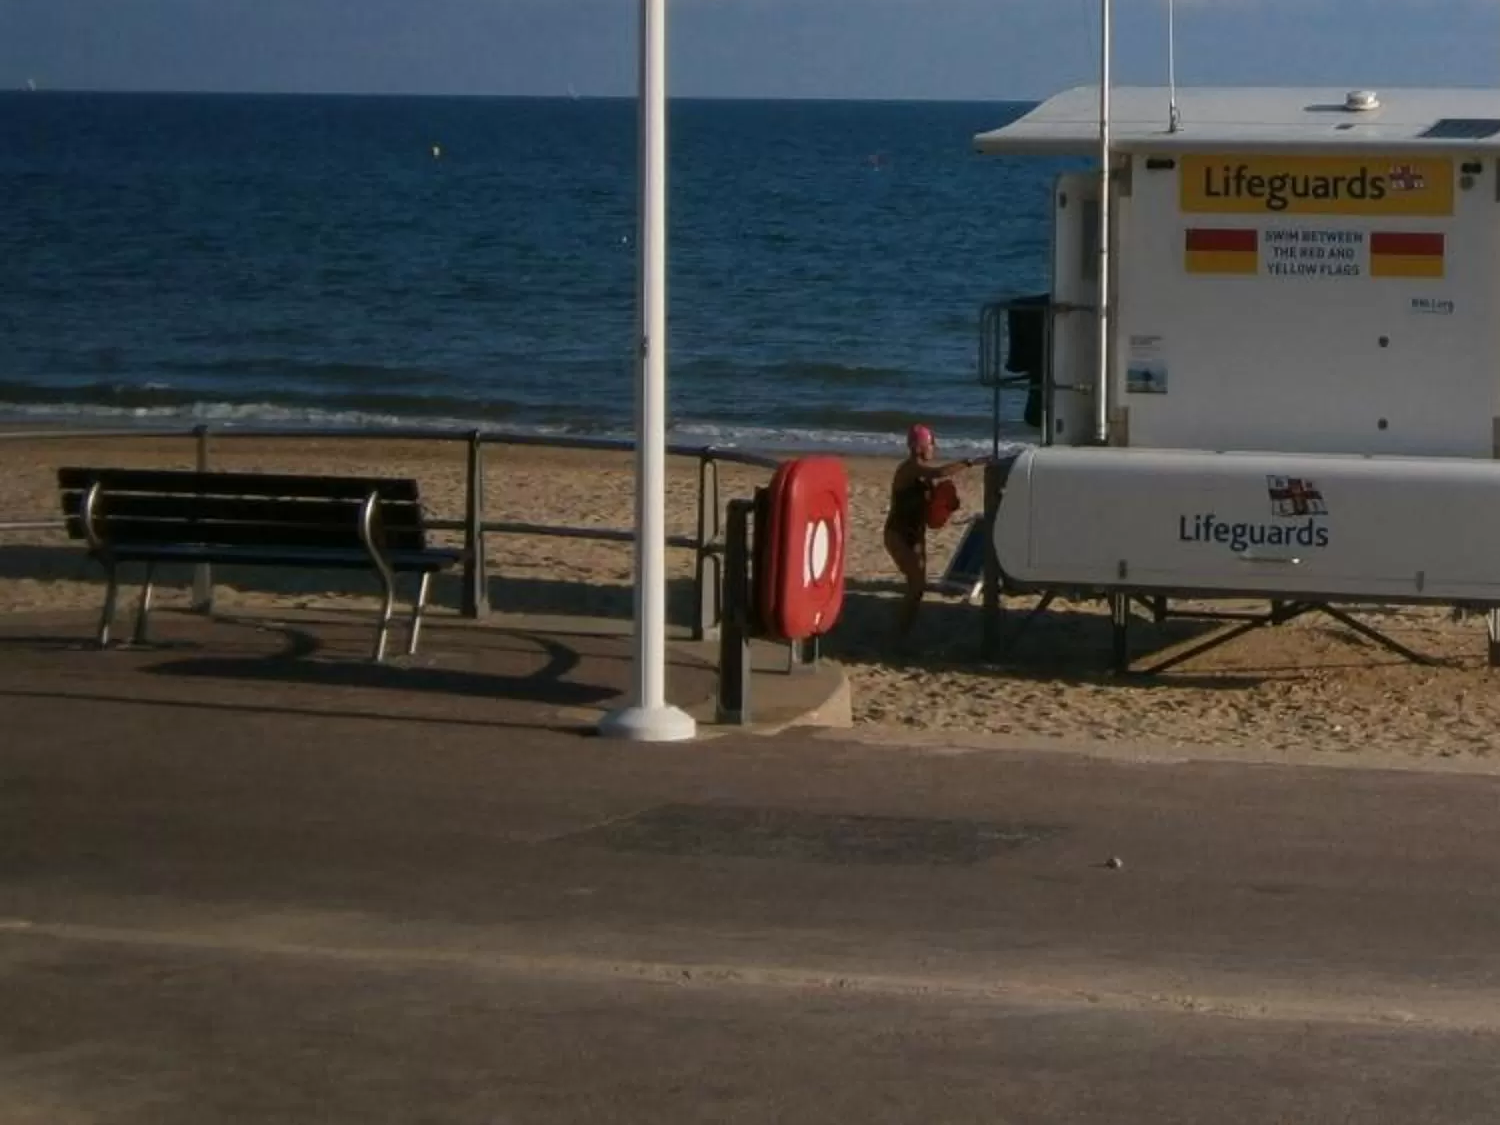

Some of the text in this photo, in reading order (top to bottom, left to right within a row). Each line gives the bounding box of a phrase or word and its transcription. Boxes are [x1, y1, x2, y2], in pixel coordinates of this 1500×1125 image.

[1203, 165, 1386, 211] Lifeguards
[1265, 230, 1299, 243] SWIM
[1273, 246, 1297, 259] THE
[1327, 248, 1355, 261] AND
[1267, 262, 1317, 276] YELLOW
[1179, 514, 1329, 552] Lifeguards
